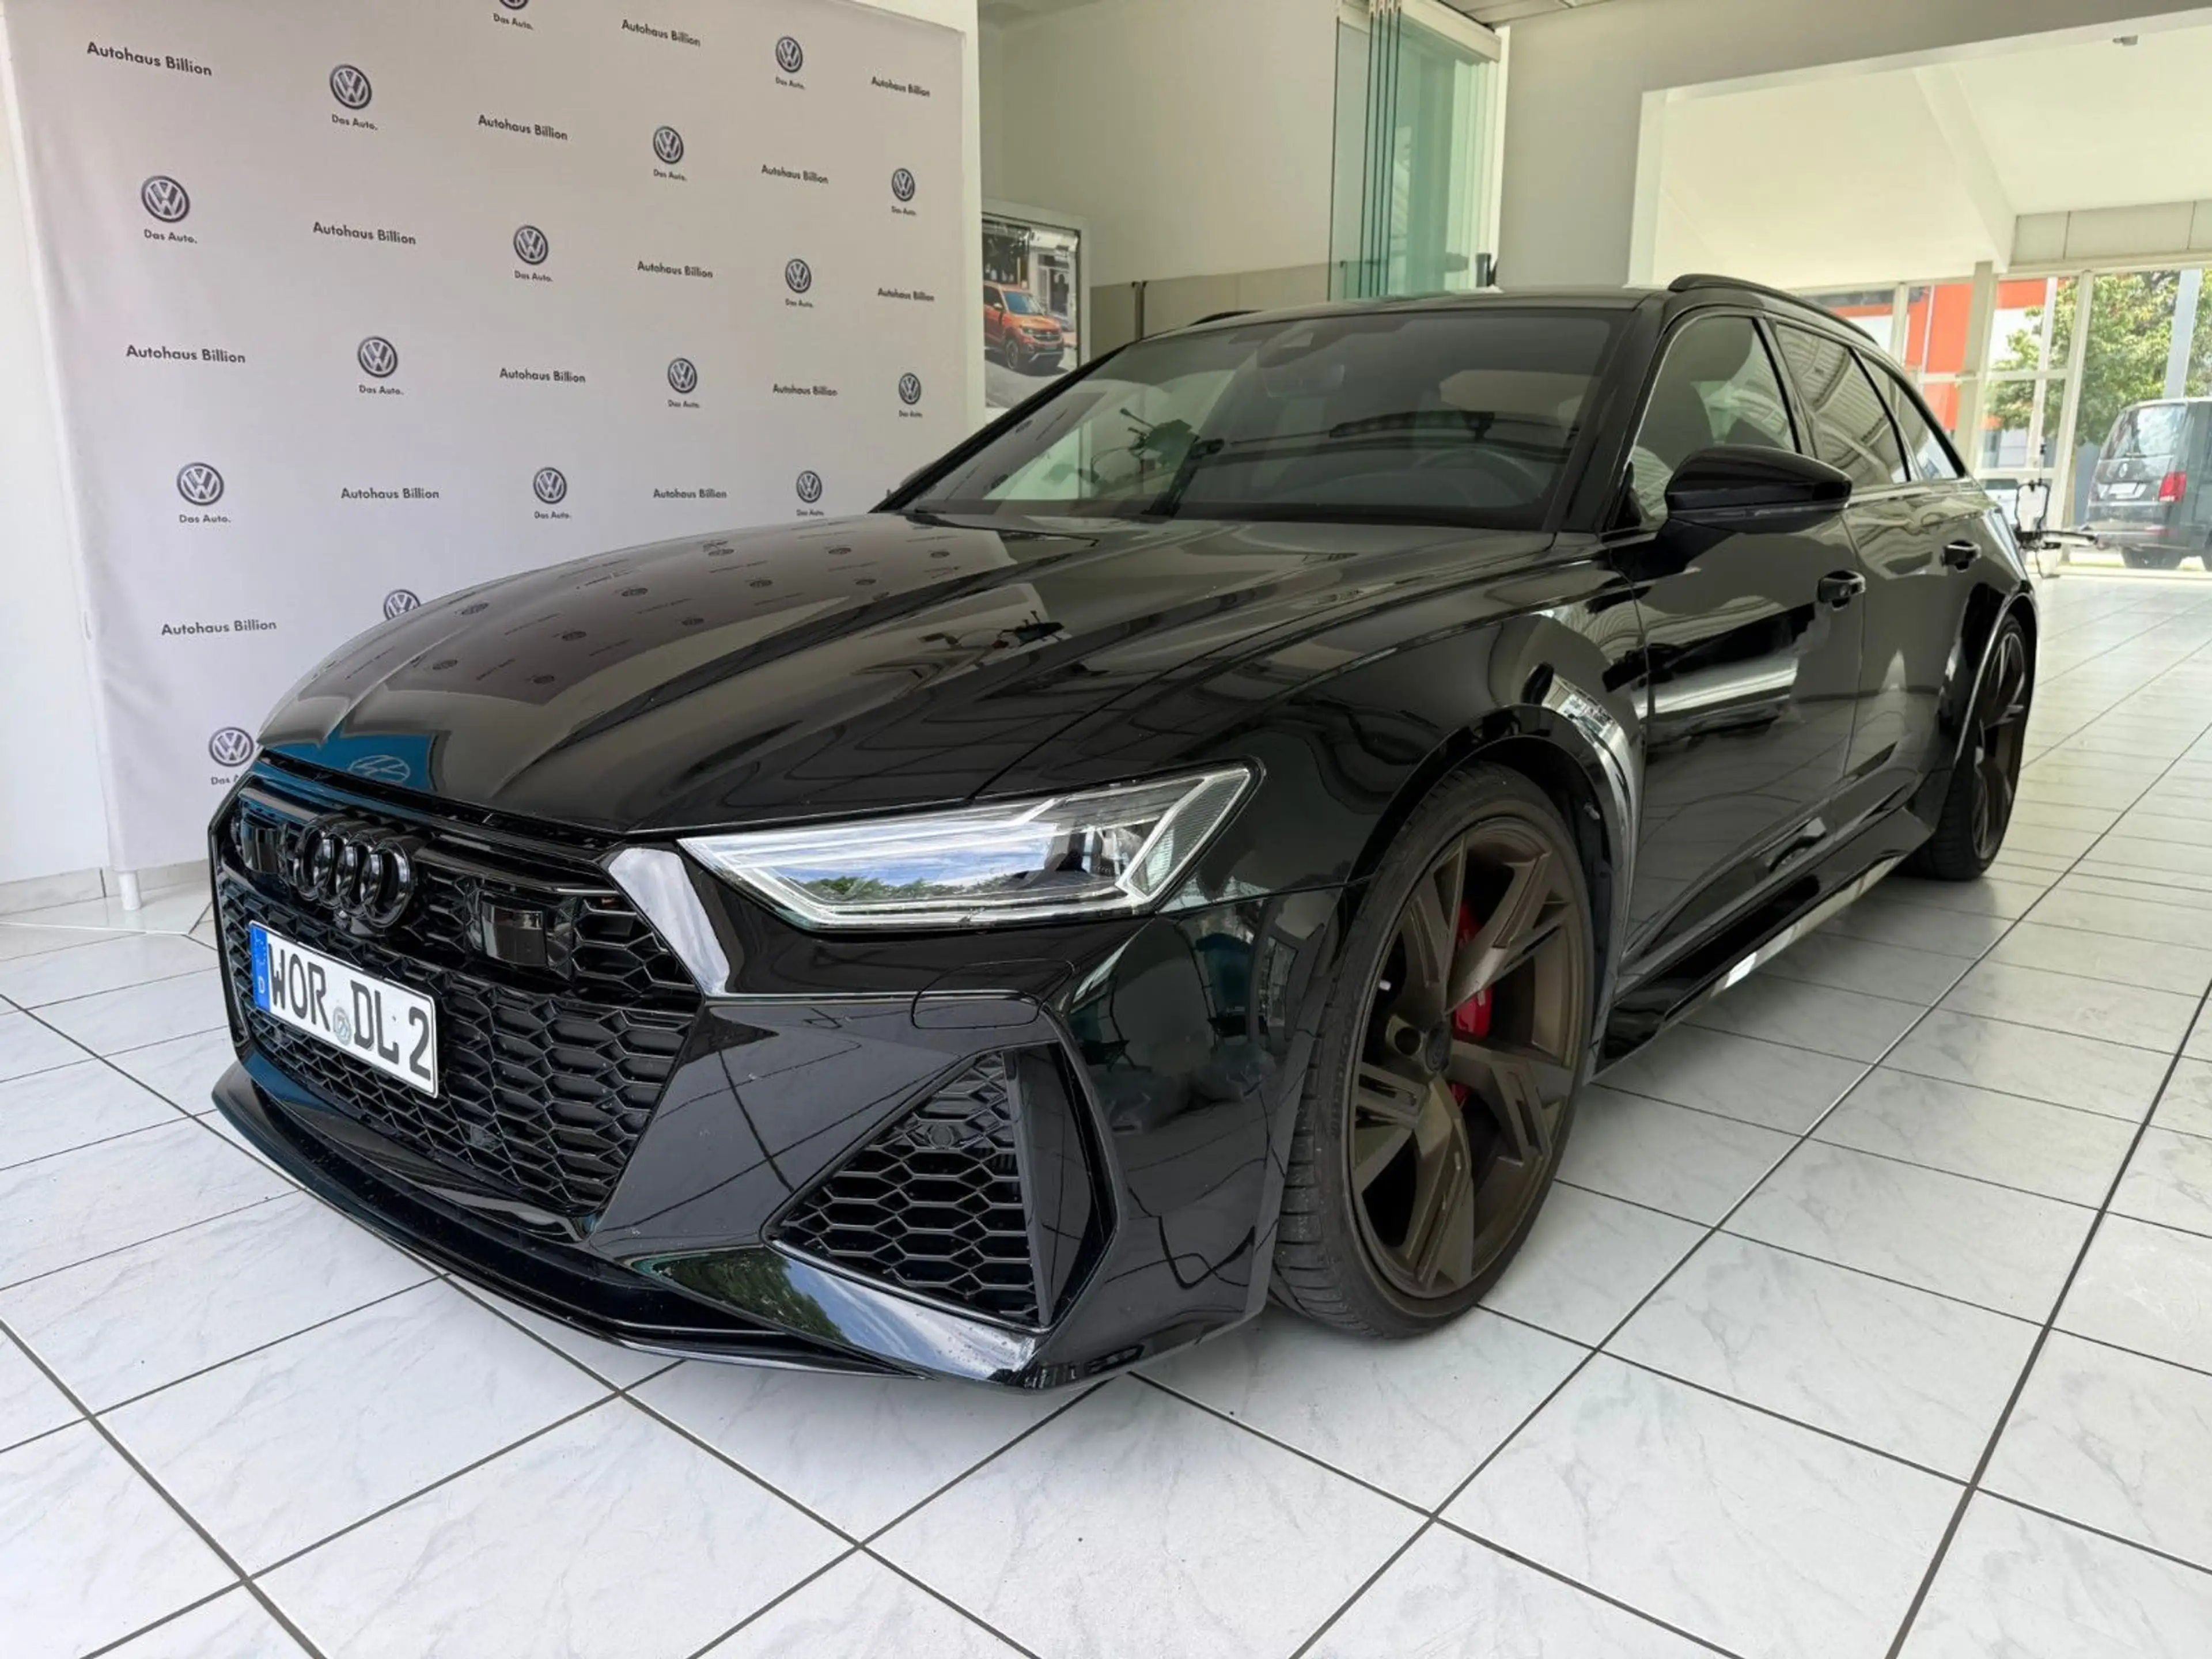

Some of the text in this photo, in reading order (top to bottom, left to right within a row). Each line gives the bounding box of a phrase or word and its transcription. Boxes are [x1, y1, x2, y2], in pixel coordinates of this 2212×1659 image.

[493, 13, 509, 24] Das
[622, 20, 700, 47] Autohaus Billion
[88, 41, 211, 76] Autohaus Billion
[871, 76, 930, 97] Autohaus Billion
[332, 114, 350, 126] Das
[478, 115, 567, 140] Autohaus Billion
[762, 164, 828, 184] Autohaus Billion
[144, 229, 165, 240] Das
[313, 222, 416, 245] Autohaus Billion
[638, 261, 713, 278] Autohaus Billion
[878, 288, 934, 301] Autohaus Billion
[126, 345, 245, 363] Autohaus Billion
[499, 368, 585, 382] Autohaus Billion
[359, 385, 376, 393] Das
[773, 384, 838, 396] Autohaus Billion
[341, 487, 439, 498] Autohaus Billion
[653, 488, 726, 498] Autohaus Billion
[179, 514, 199, 523] Das
[162, 619, 276, 635] Autohaus Billion
[210, 776, 230, 785] Das
[268, 943, 431, 1080] WOR DL 2
